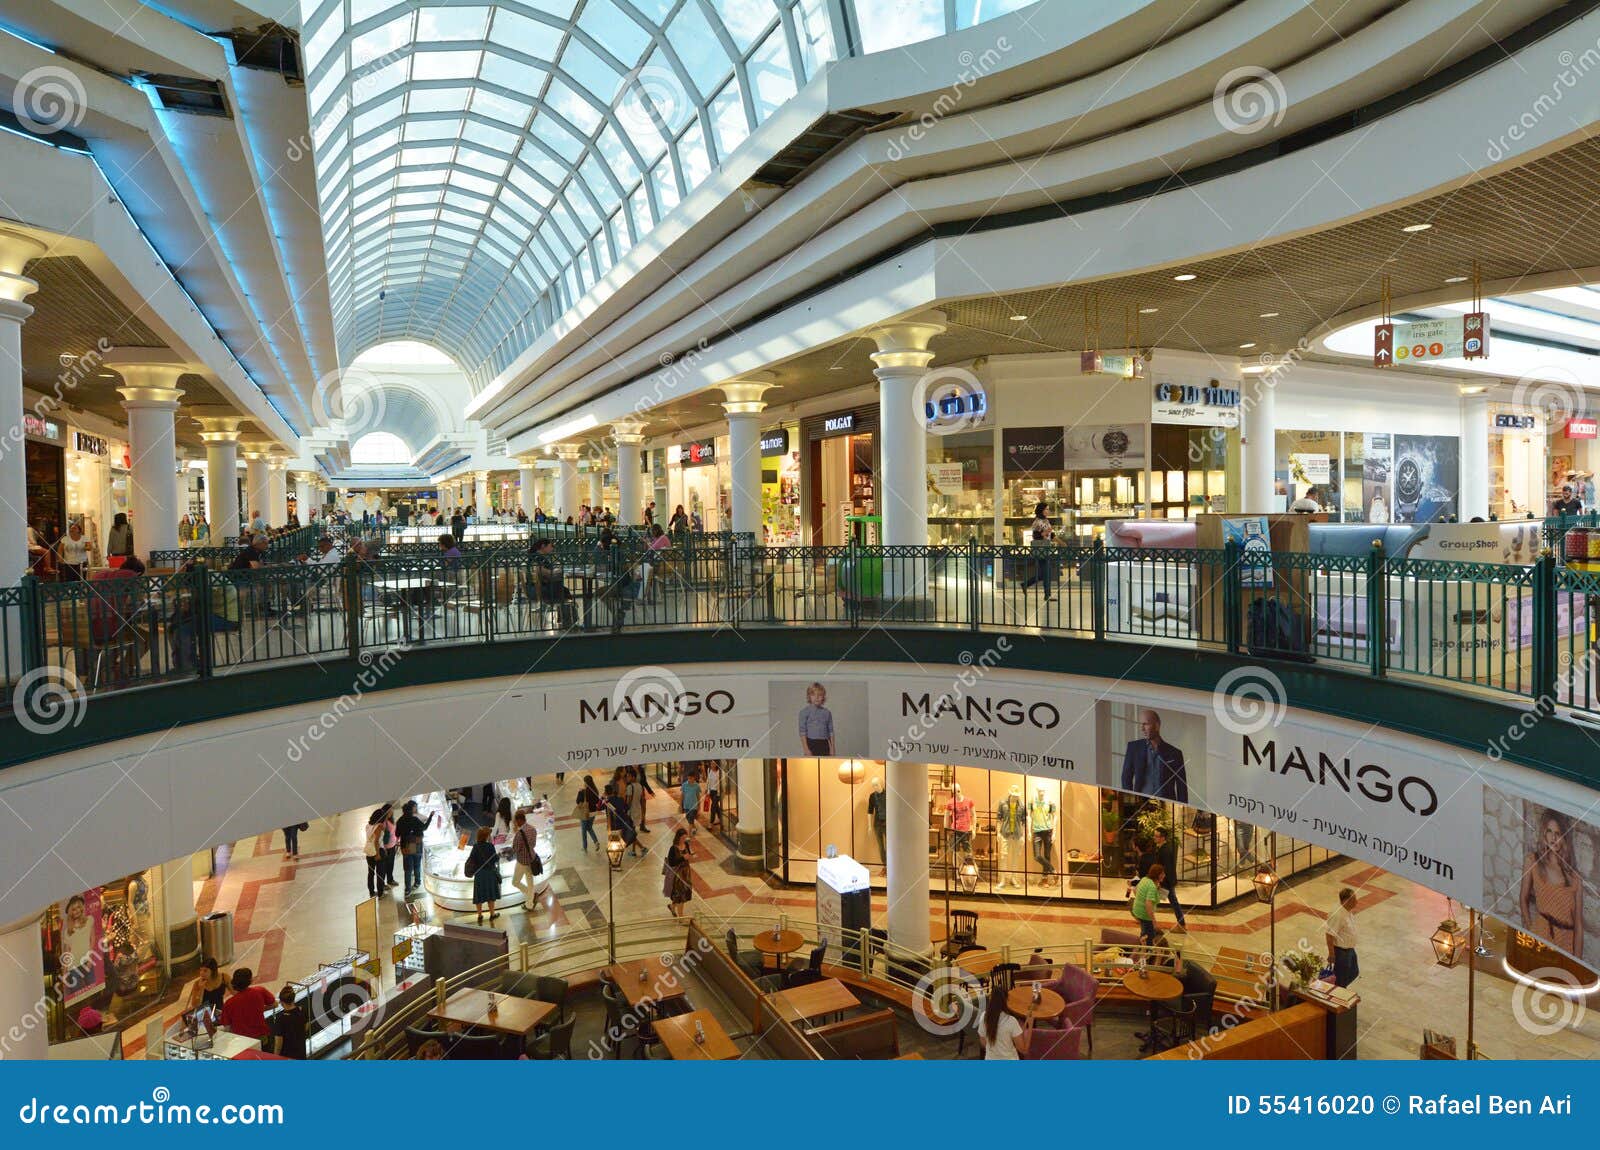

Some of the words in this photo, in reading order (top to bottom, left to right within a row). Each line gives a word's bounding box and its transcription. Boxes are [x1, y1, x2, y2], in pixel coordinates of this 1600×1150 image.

[1204, 387, 1241, 408] TIME
[825, 416, 853, 431] POLGAT
[579, 690, 735, 724] MANGO
[902, 692, 1061, 730] MANGO
[640, 722, 676, 733] KIDS
[964, 726, 998, 738] MAN
[604, 745, 627, 757] שער
[641, 741, 684, 754] אמצעית
[688, 739, 716, 752] קומה
[719, 738, 750, 749] חדש!
[891, 741, 921, 754] רקפת
[925, 743, 949, 754] שער
[567, 747, 598, 761] רקפת
[963, 745, 1006, 760] אמצעית
[1010, 751, 1038, 766] קומה
[1043, 755, 1074, 770] חדש!
[1242, 734, 1438, 817] MANGO
[1228, 793, 1264, 814] רקפת
[1269, 804, 1297, 823] שער
[1312, 817, 1367, 846] אמצעית
[1373, 837, 1408, 862] קומה
[1413, 851, 1454, 880] חדש!
